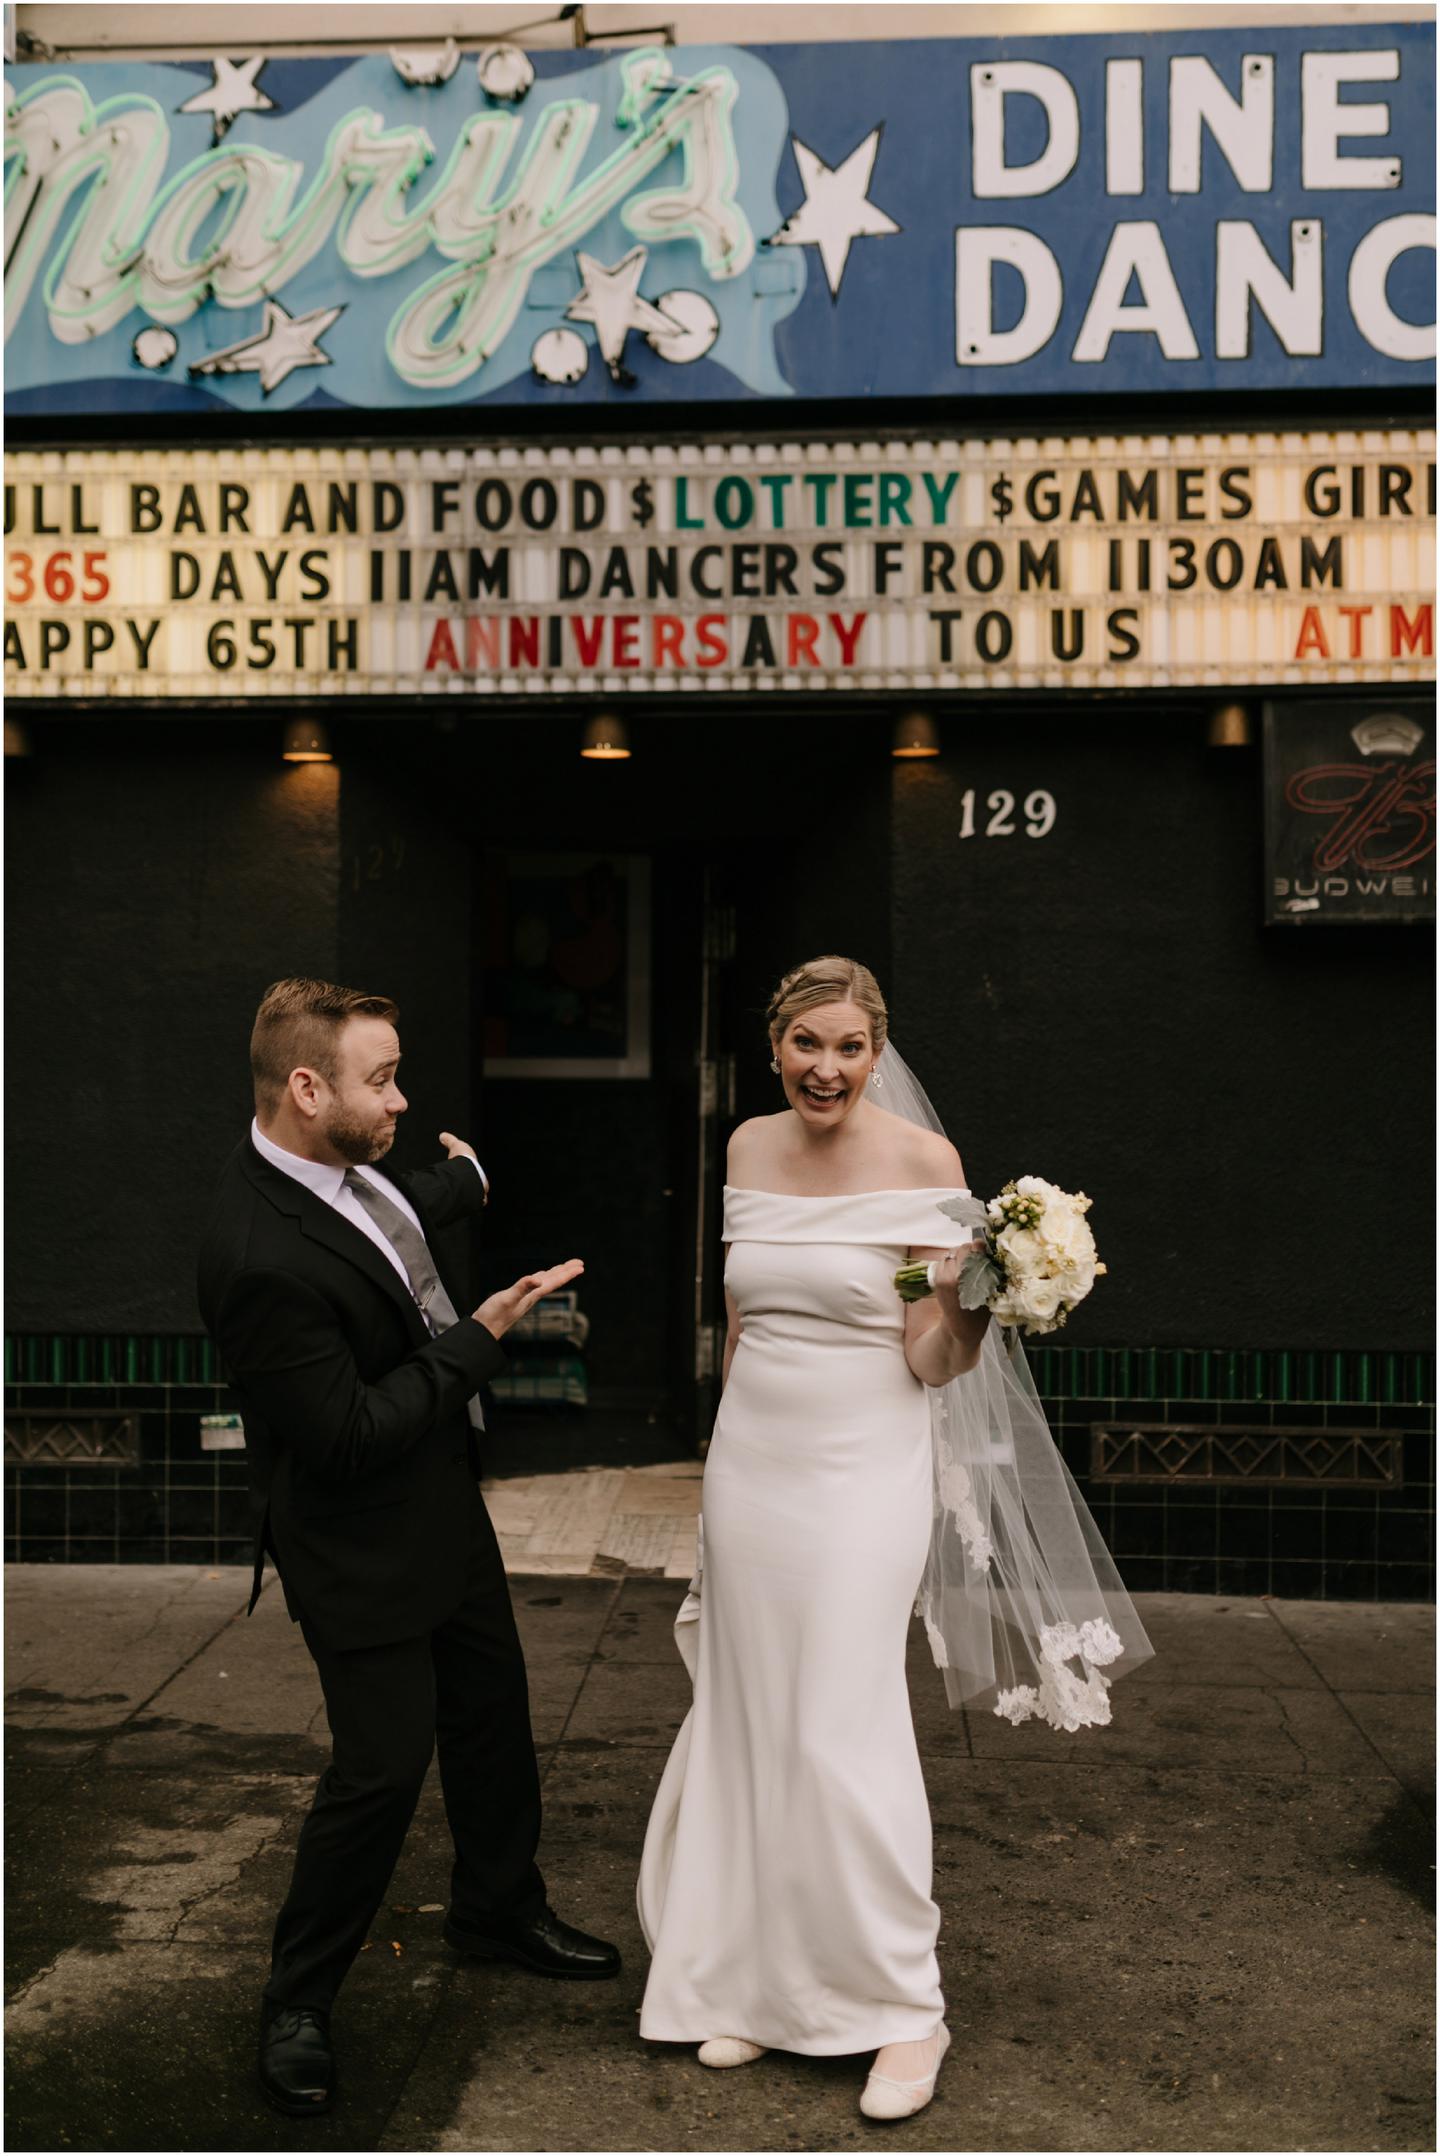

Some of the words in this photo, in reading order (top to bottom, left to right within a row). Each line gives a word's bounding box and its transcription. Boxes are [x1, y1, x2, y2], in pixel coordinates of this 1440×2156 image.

[970, 49, 1401, 199] DINE
[954, 213, 1436, 366] DANC
[130, 483, 250, 534] BAR
[282, 481, 405, 533] AND
[432, 478, 606, 532] FOOD
[676, 471, 960, 530] LOTTERY
[7, 552, 111, 603] 365
[170, 549, 331, 601] DAYS
[558, 541, 846, 600] DANCERS
[874, 537, 1060, 594] FROM
[207, 618, 358, 671] 65TH
[425, 611, 867, 670] ANNIVERSARY
[929, 609, 1013, 664] TO
[1051, 607, 1141, 662] US
[1295, 604, 1433, 660] ATM
[959, 789, 1057, 838] 129
